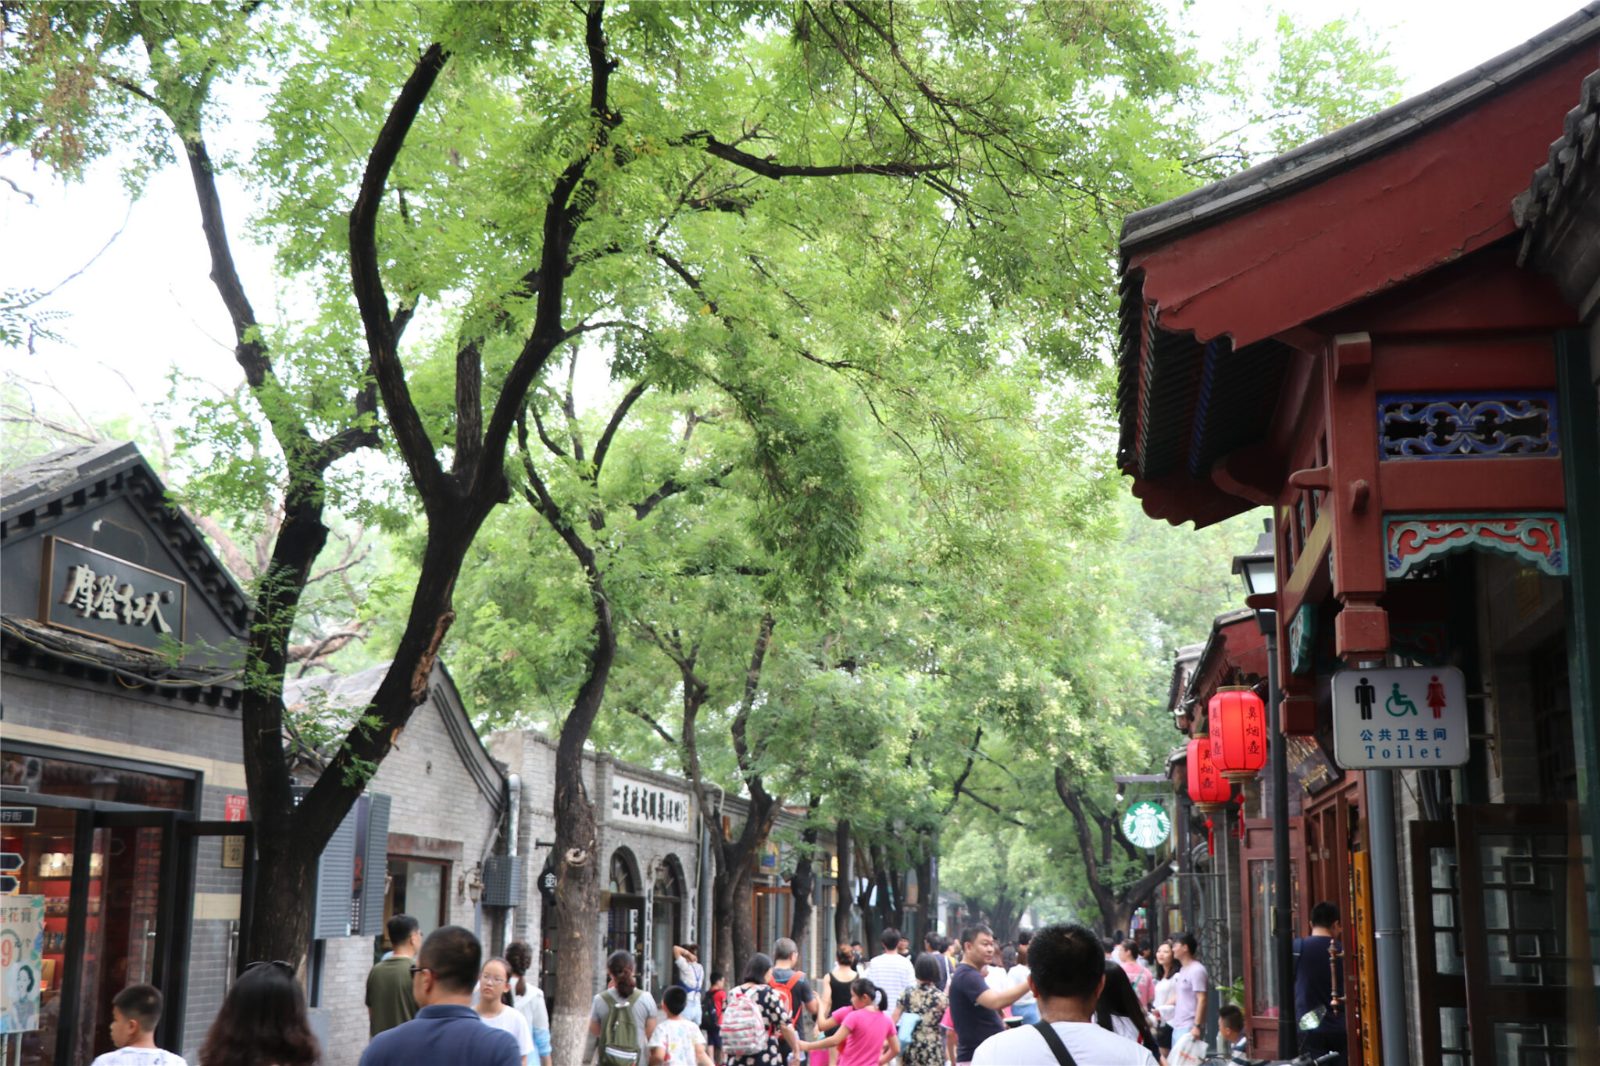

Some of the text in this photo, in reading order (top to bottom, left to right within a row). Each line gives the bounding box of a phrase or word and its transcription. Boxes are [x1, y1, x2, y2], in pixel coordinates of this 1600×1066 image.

[66, 564, 173, 633] 摩登红人
[1246, 706, 1260, 755] 鼻烟壶
[1360, 728, 1447, 741] 公共卫生间
[1364, 745, 1442, 759] Toilet
